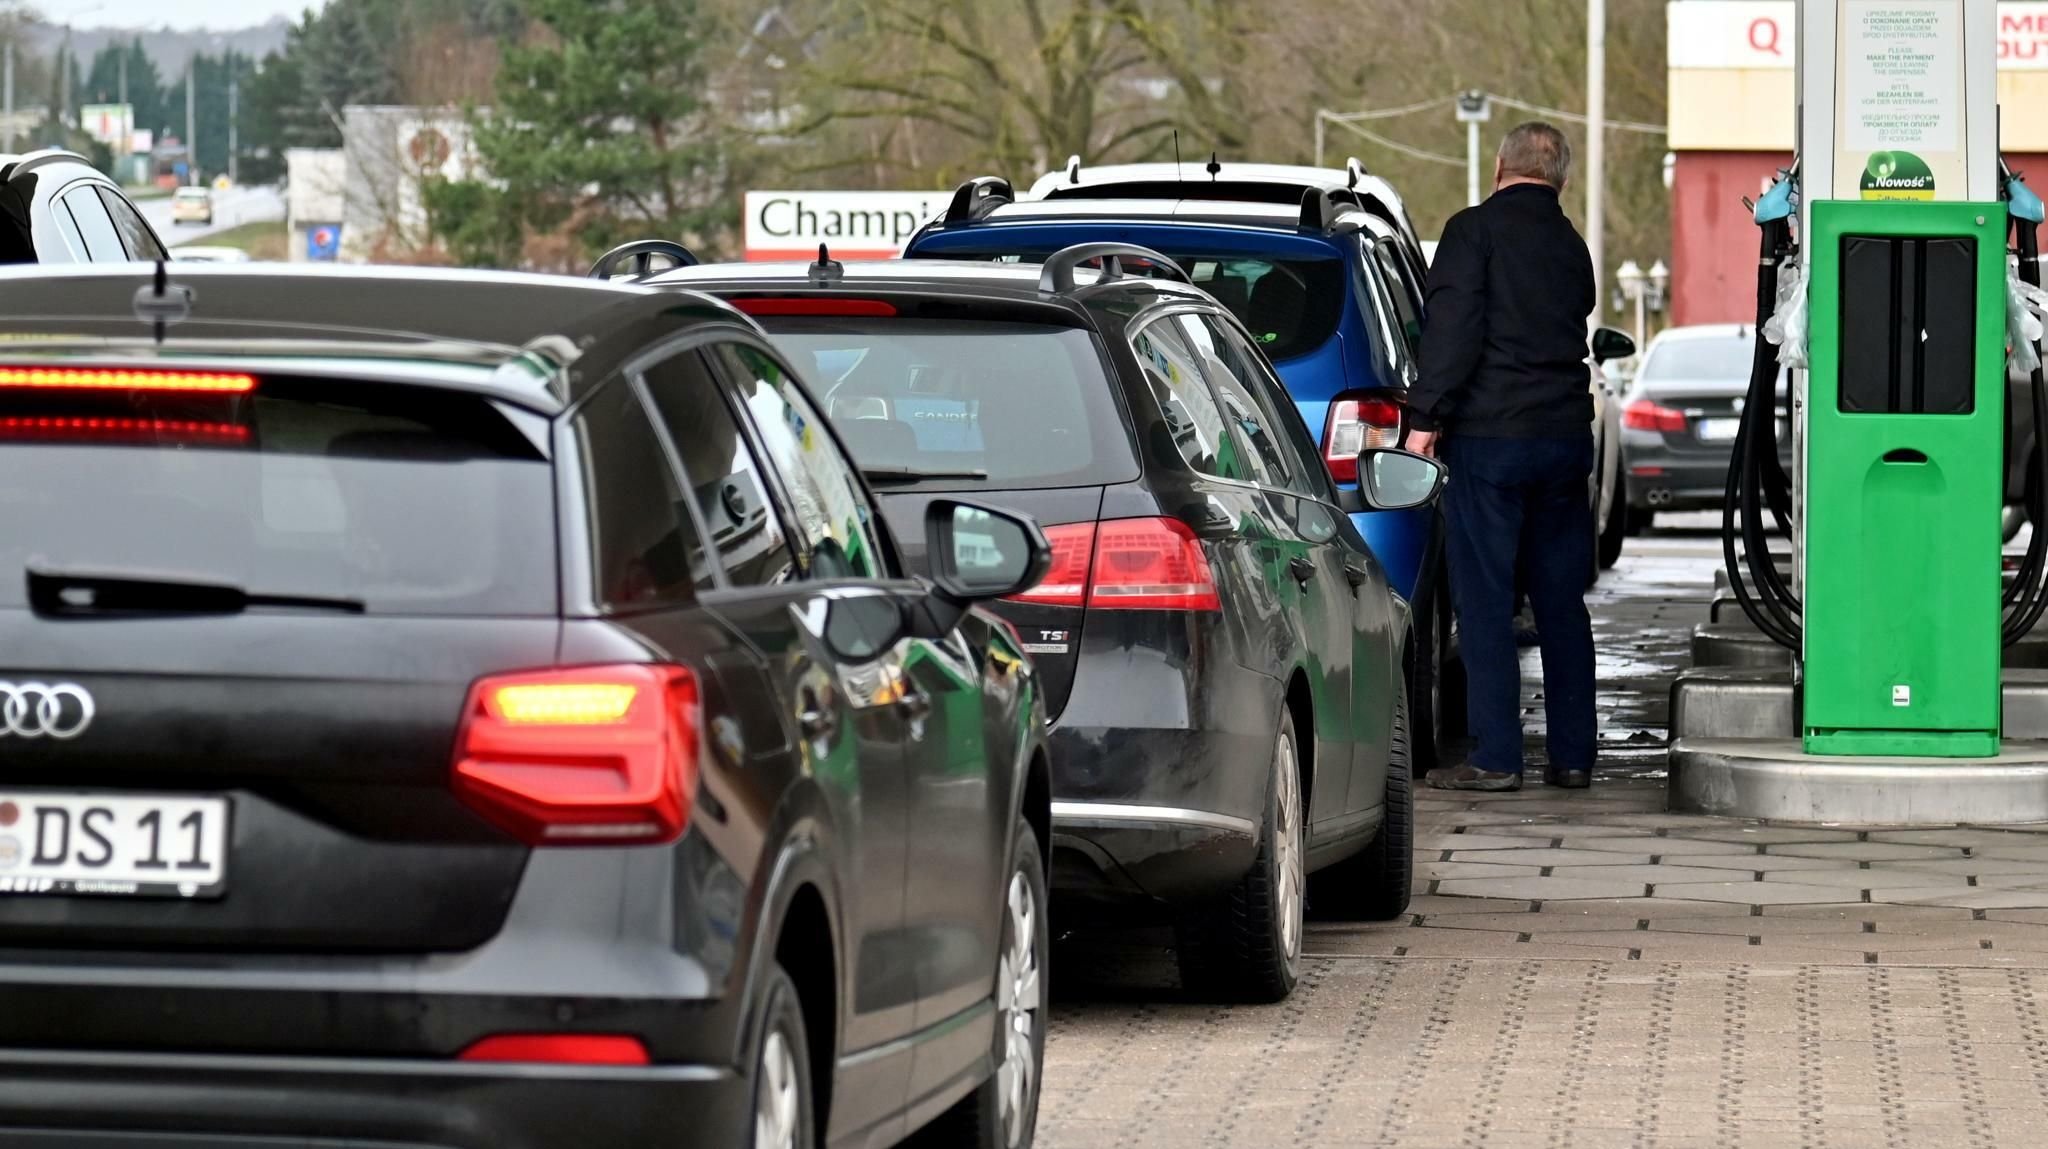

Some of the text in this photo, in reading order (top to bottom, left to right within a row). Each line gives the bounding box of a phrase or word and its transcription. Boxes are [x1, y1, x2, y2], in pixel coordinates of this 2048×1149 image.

[1747, 18, 1782, 56] Q
[31, 806, 211, 870] DS 11
